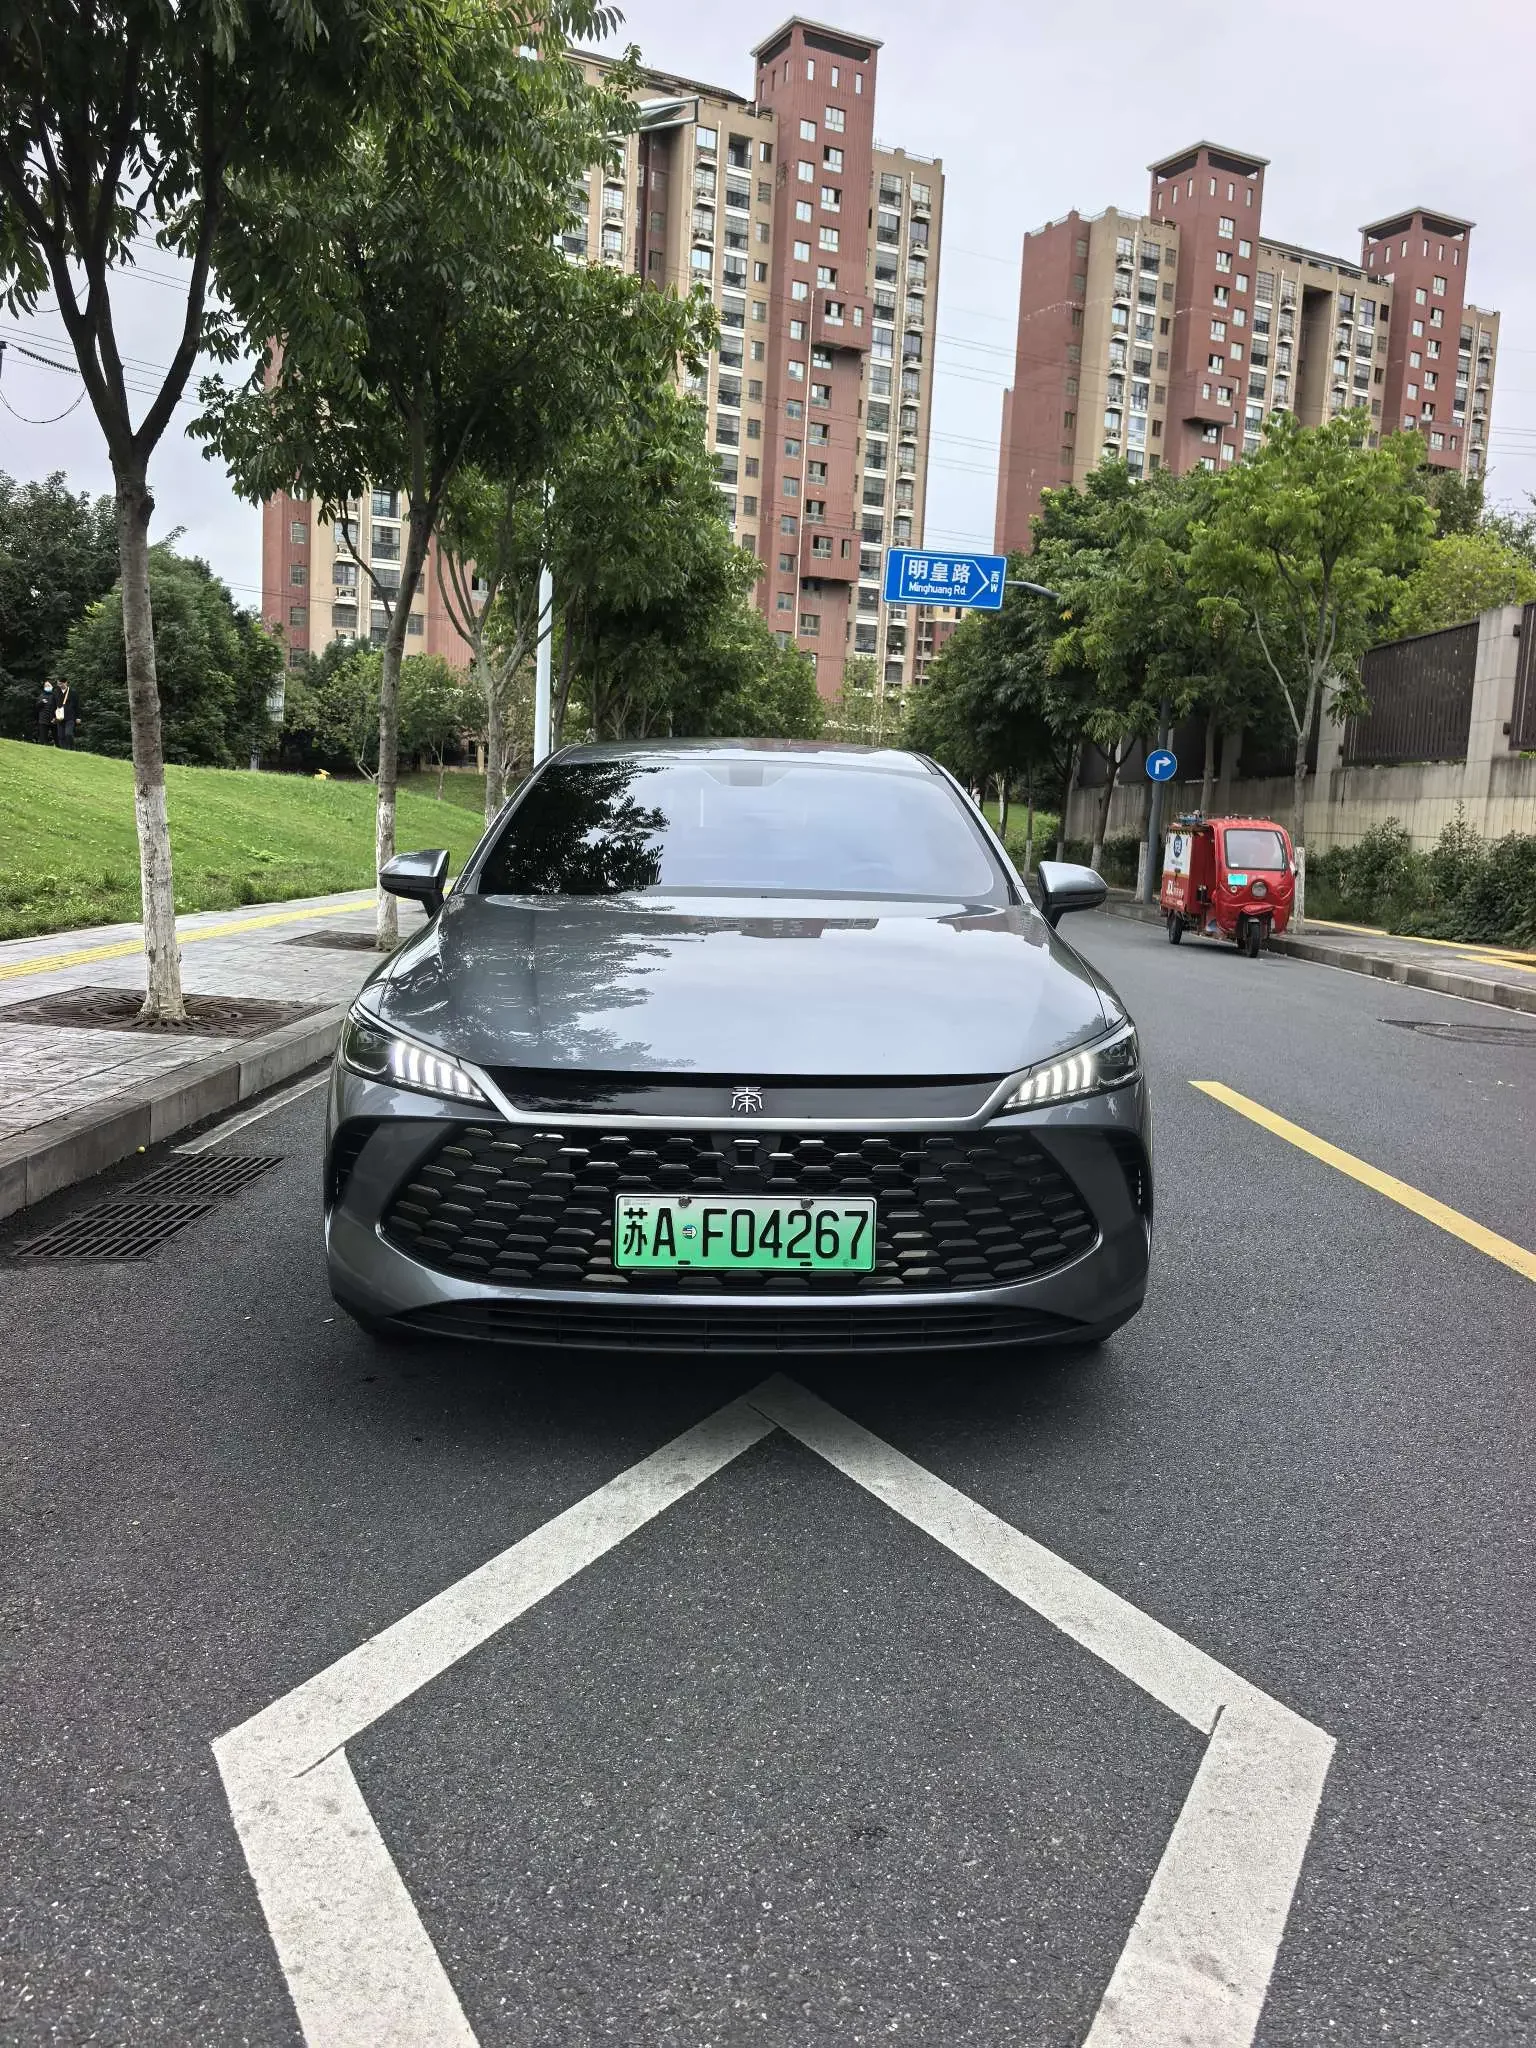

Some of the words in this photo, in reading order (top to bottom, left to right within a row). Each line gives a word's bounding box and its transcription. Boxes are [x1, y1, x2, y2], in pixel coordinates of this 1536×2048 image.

[908, 560, 971, 584] 明皇路
[990, 570, 1001, 583] 西
[908, 581, 952, 596] Minghuang
[990, 583, 1000, 593] W
